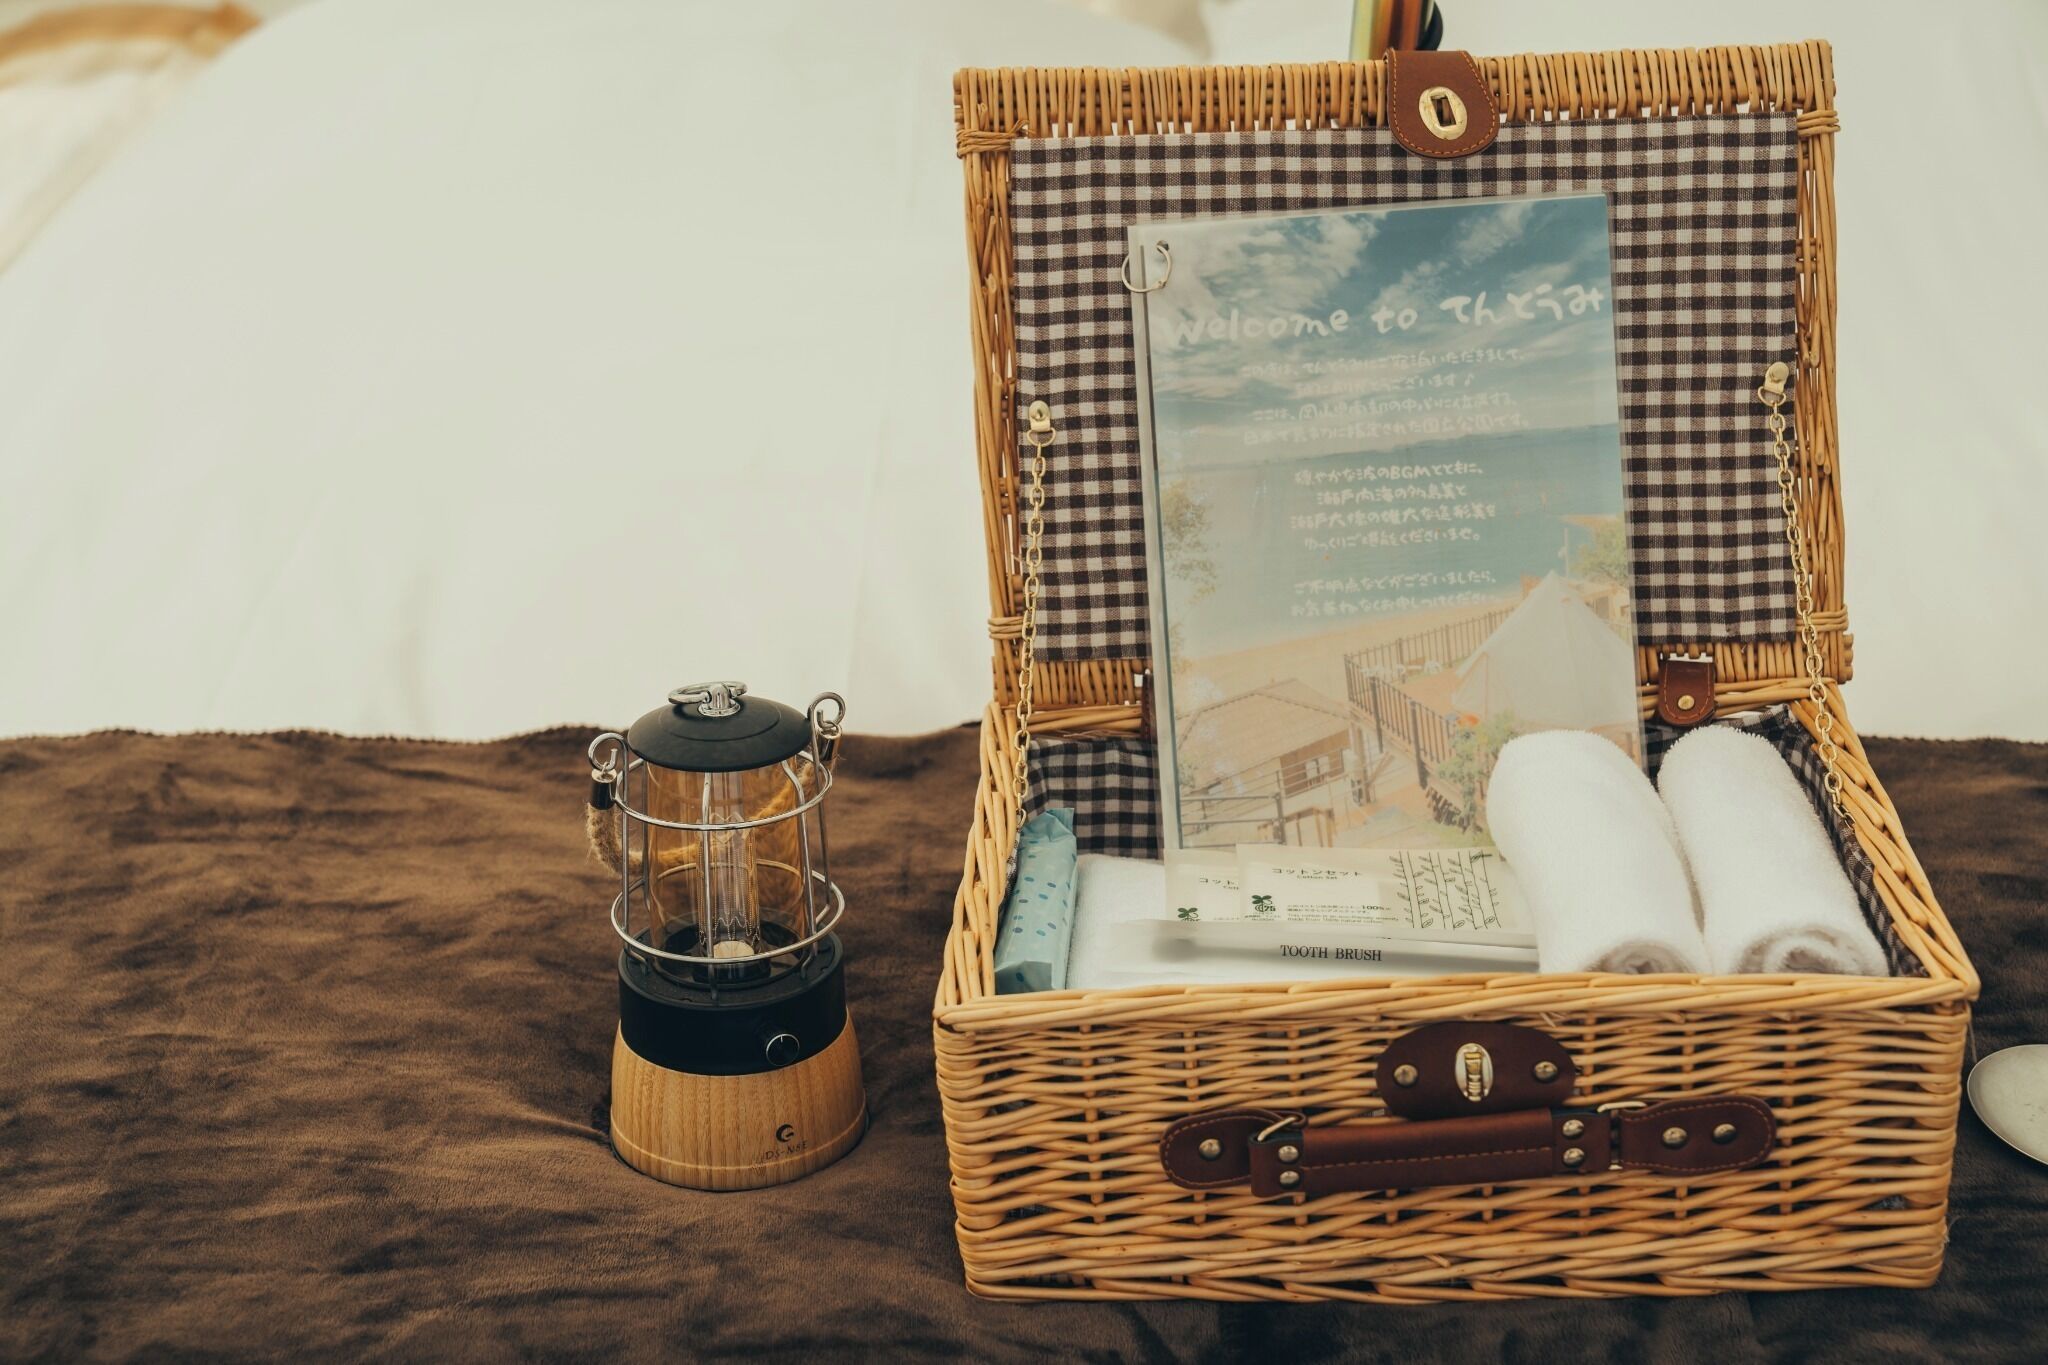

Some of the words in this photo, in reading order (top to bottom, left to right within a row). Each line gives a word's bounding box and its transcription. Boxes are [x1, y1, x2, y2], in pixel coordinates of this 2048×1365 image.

[1370, 307, 1419, 334] to
[1271, 867, 1363, 878] コットンセット
[1279, 944, 1328, 959] TOOTH
[1335, 947, 1383, 962] BRUSH
